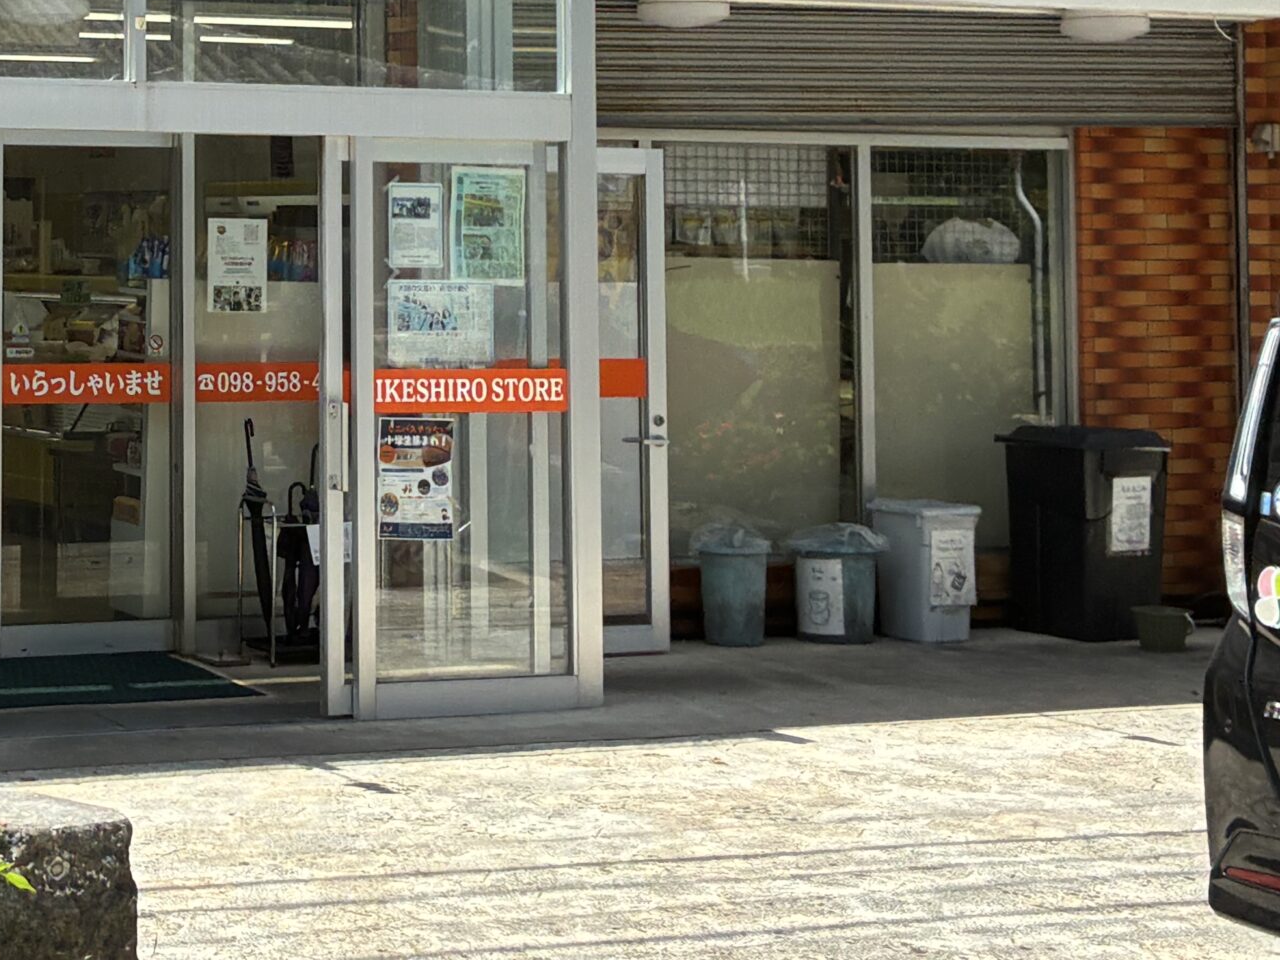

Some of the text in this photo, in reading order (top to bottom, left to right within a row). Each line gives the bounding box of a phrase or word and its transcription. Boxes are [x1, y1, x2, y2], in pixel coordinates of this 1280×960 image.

[9, 369, 164, 397] いらっしゃいませ
[375, 377, 564, 404] IKESHIRO STORE
